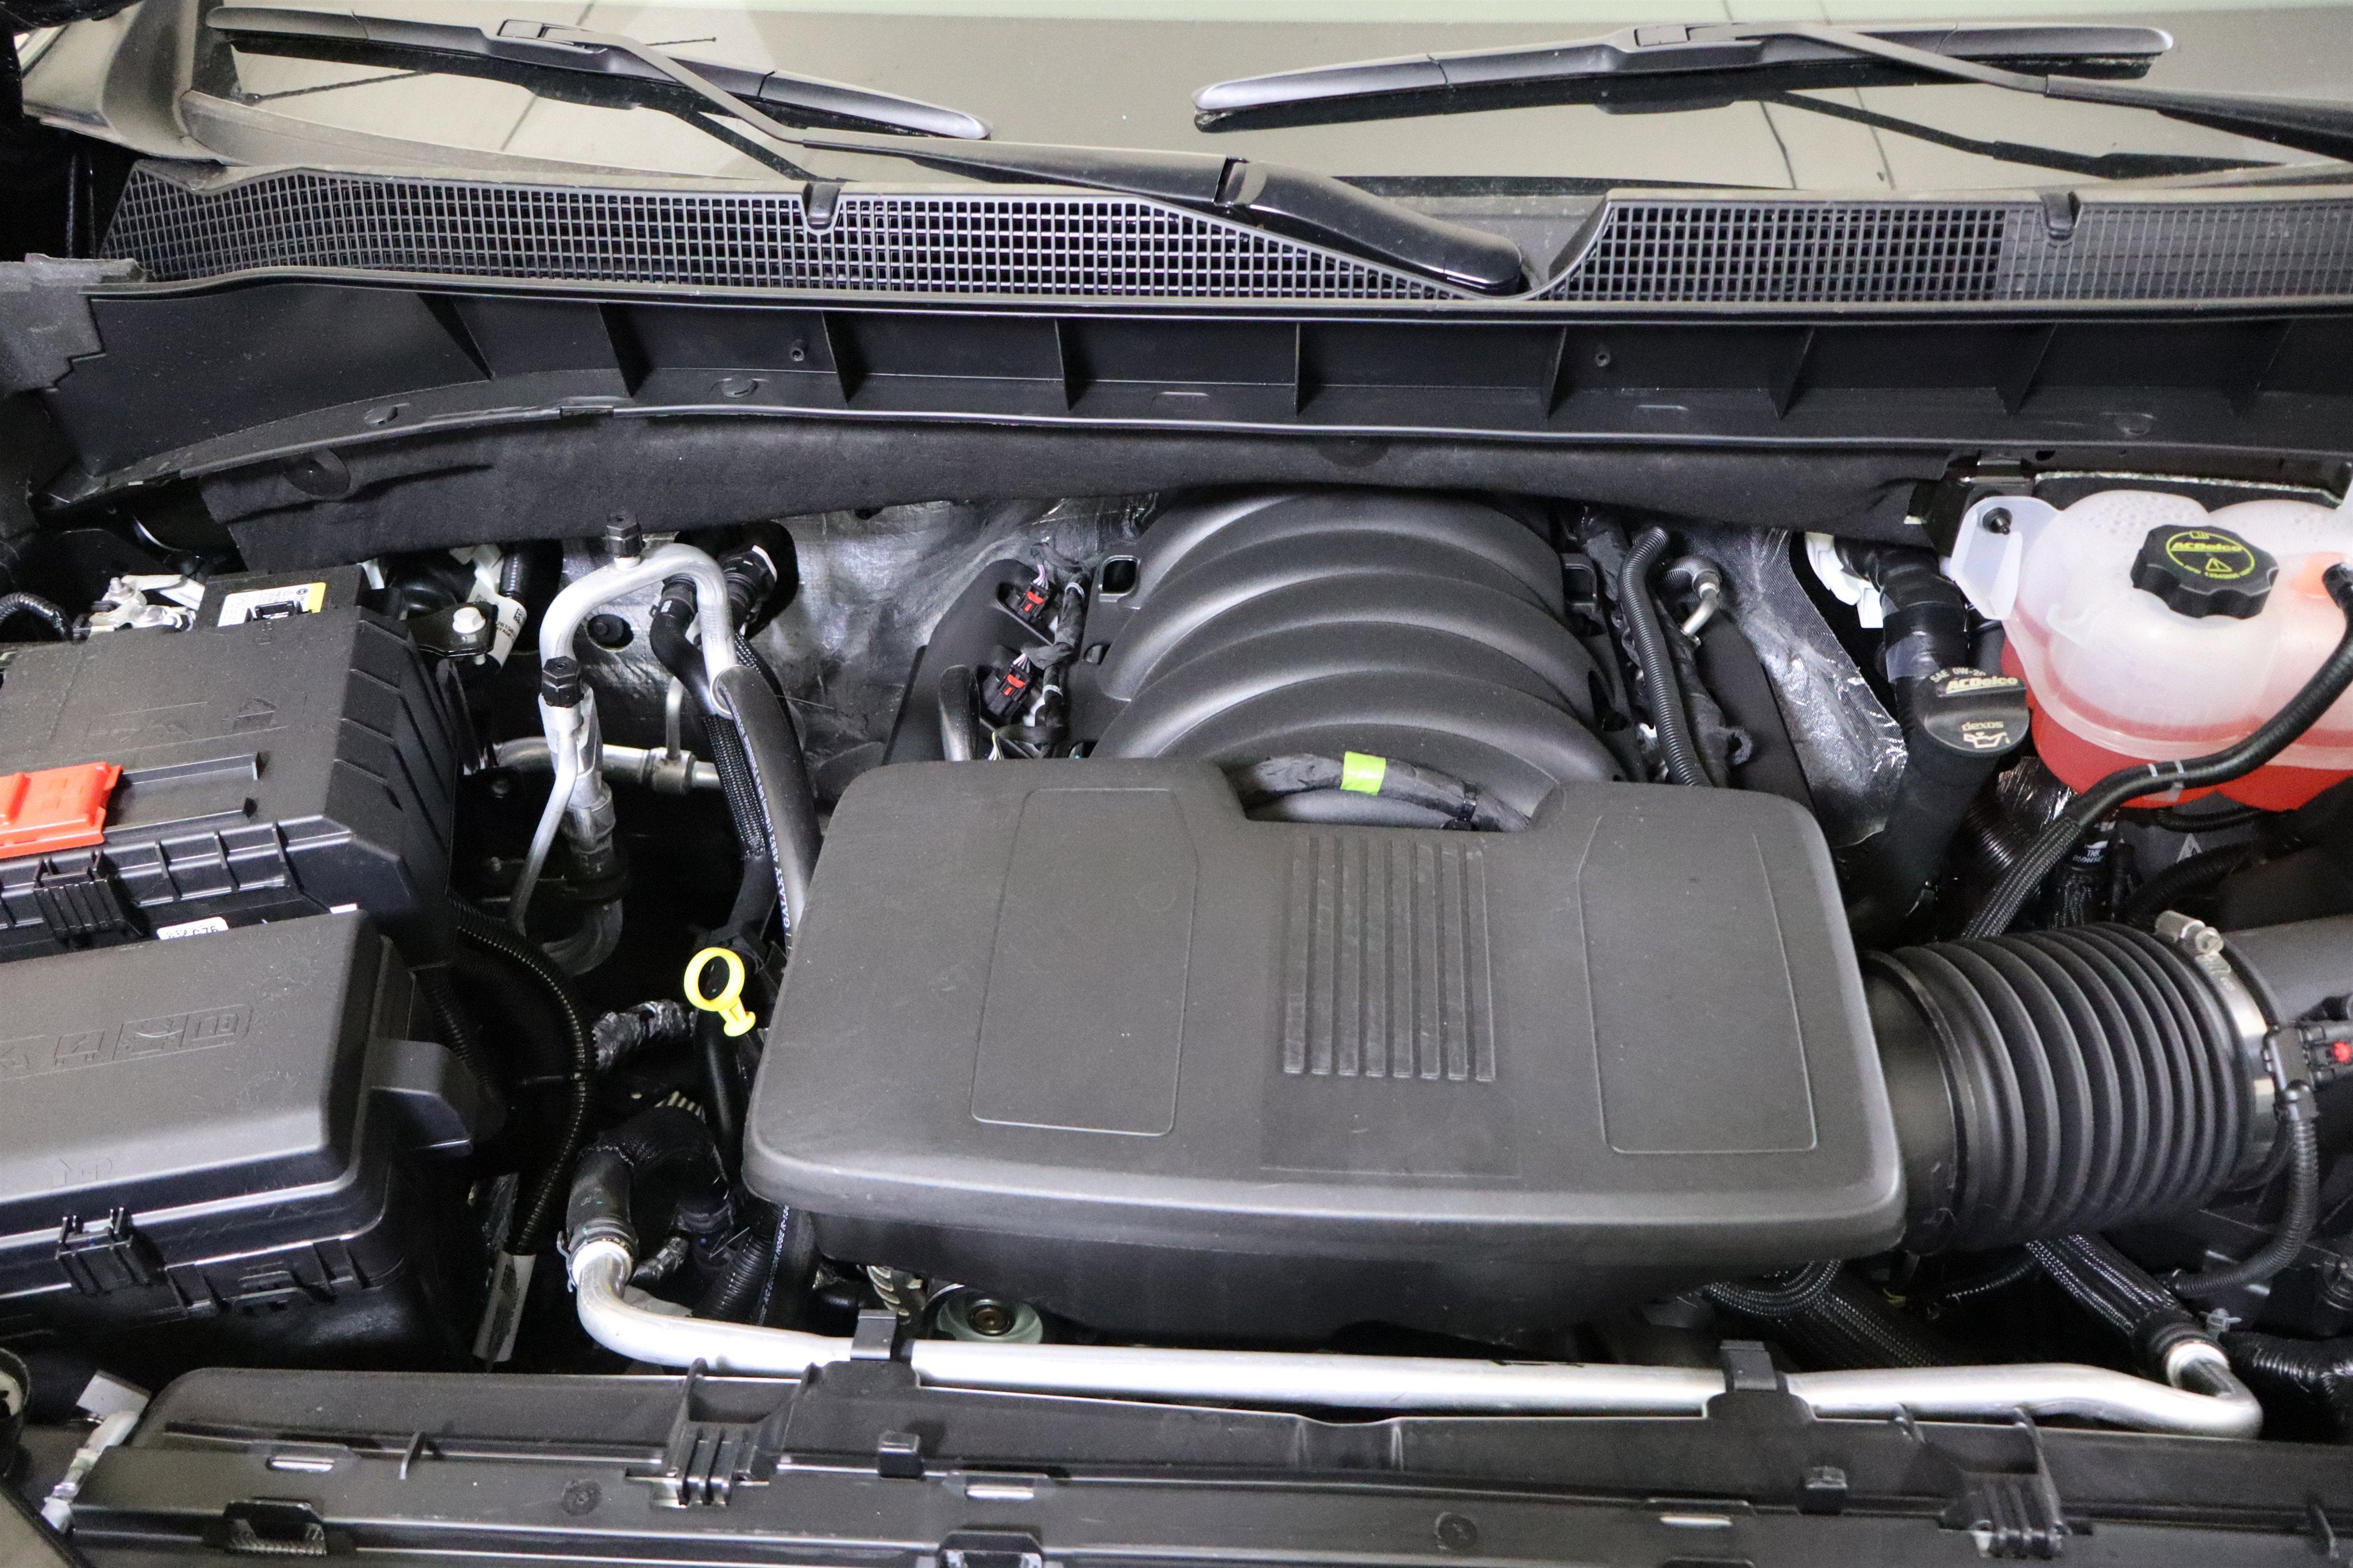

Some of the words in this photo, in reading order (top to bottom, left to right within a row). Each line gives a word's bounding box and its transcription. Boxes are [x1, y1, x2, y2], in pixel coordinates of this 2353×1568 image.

[1930, 669, 1950, 683] SAE
[1946, 676, 2018, 693] ACDelco
[1961, 721, 2004, 731] dexos
[762, 798, 773, 832] (16mm)
[770, 835, 778, 862] 4882
[776, 867, 790, 928] GALAXY
[776, 1230, 785, 1255] HOSE
